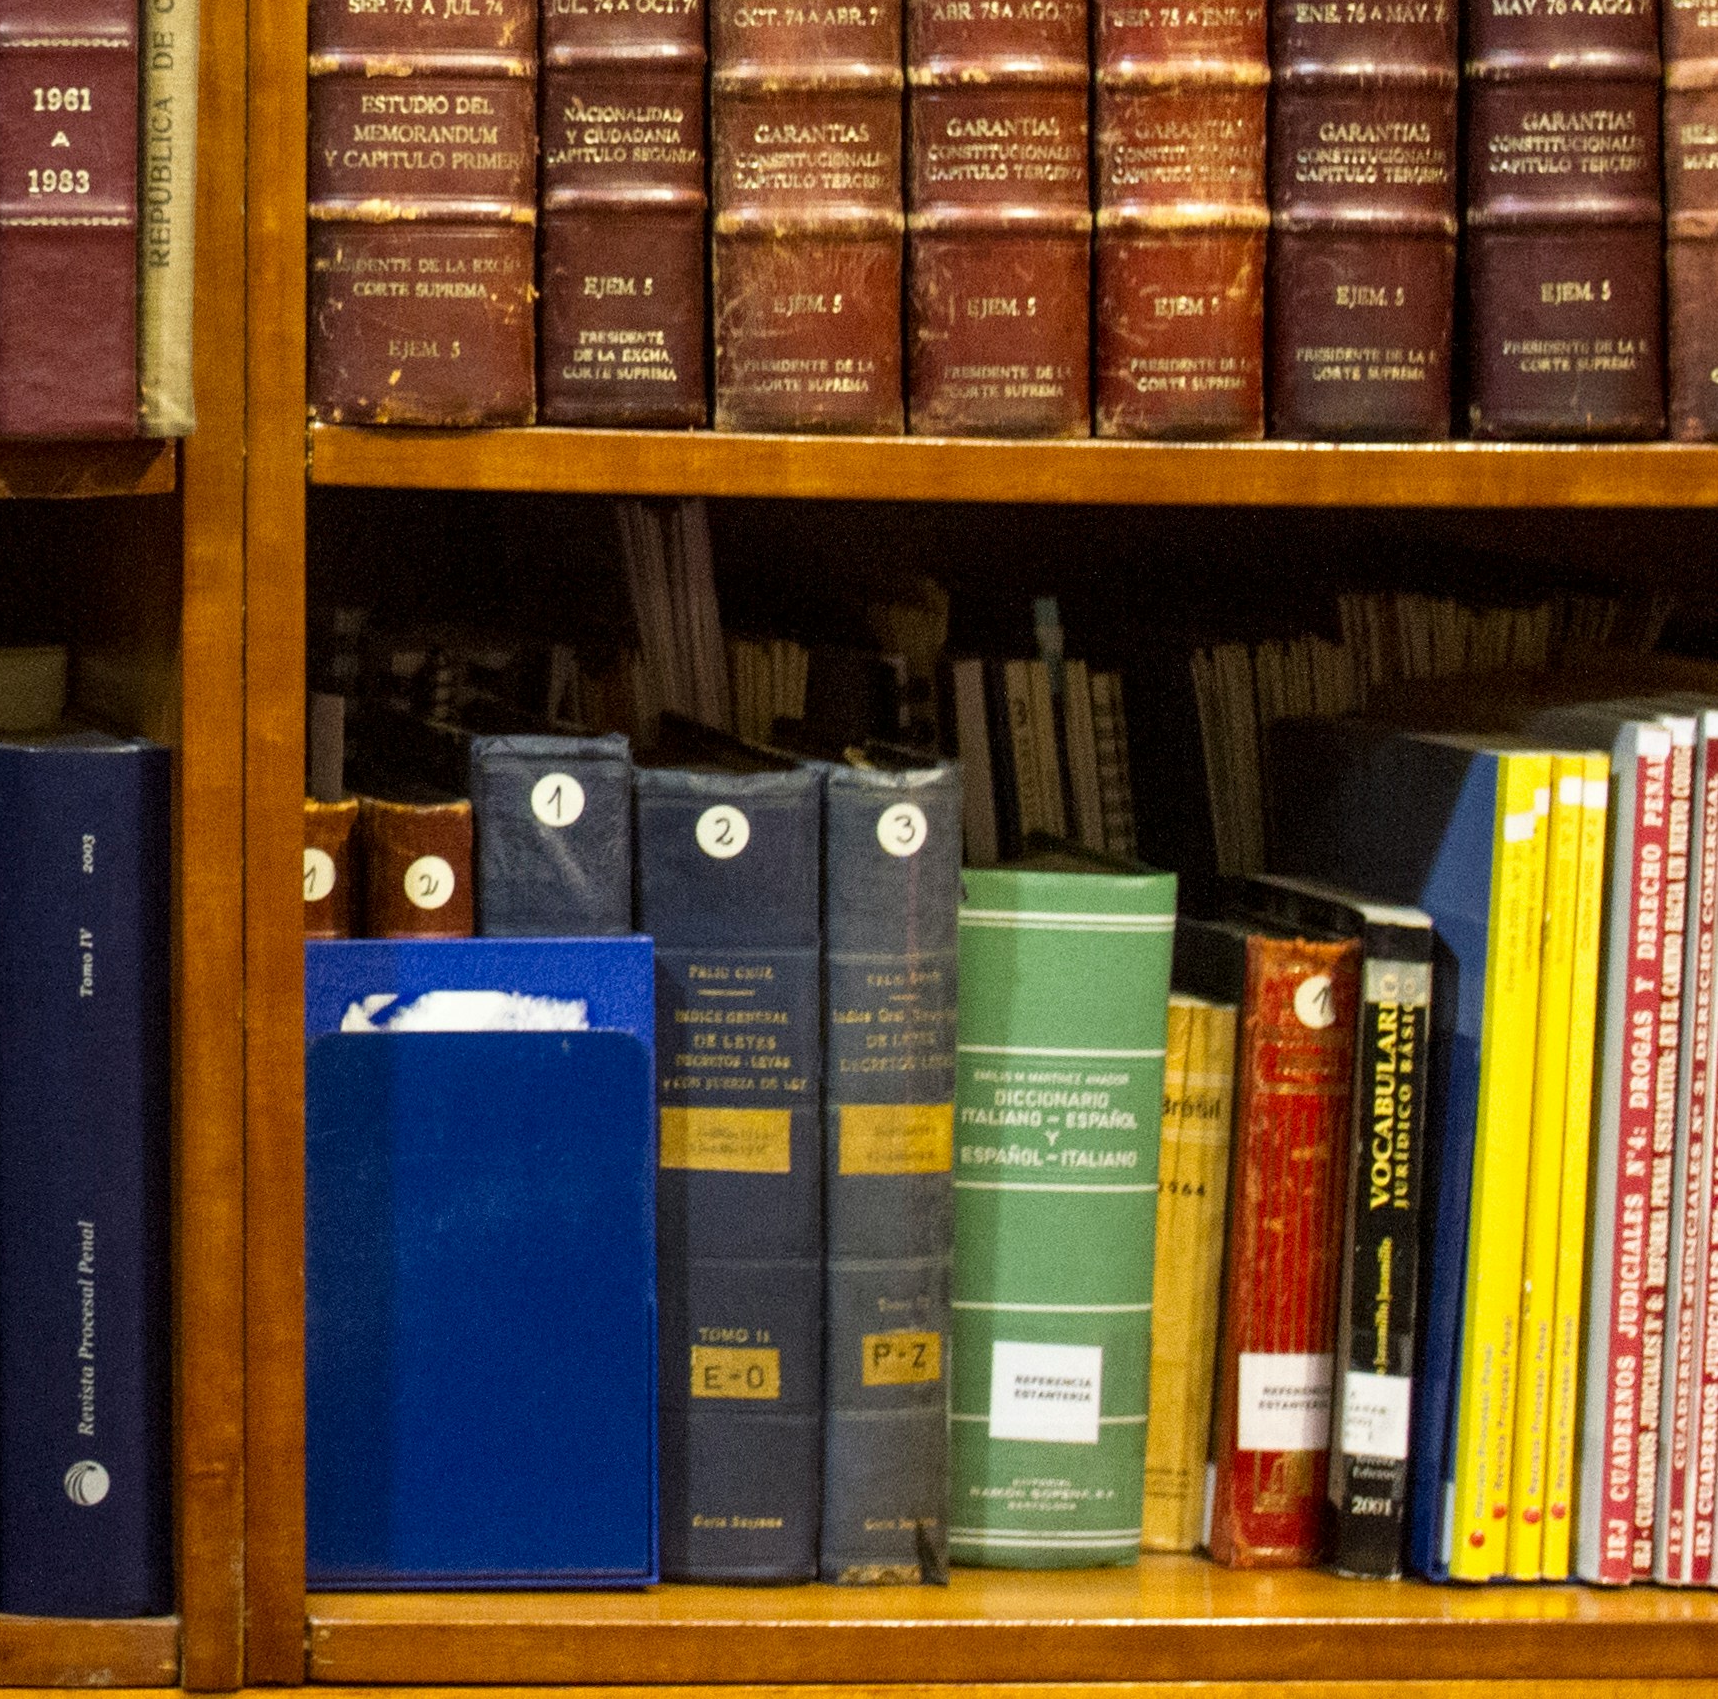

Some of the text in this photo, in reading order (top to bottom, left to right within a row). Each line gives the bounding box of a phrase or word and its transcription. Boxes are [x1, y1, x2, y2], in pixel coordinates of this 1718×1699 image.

[151, 30, 175, 71] DE
[33, 88, 92, 112] 1961
[362, 96, 494, 116] ESTUDIO DEL
[51, 131, 70, 148] A
[353, 124, 498, 145] MEMORANDUM
[28, 170, 90, 194] 1983
[148, 95, 175, 269] REPUBLICA
[714, 818, 734, 846] 2
[894, 814, 916, 845] 3
[81, 834, 96, 874] 2003
[1637, 843, 1662, 961] DERECHO
[80, 928, 94, 997] Tomo IV
[1633, 975, 1655, 993] Y
[1629, 1009, 1653, 1109] DROGAS
[994, 1088, 1109, 1108] DICCIONARIO
[962, 1108, 1042, 1127] ITALIANO
[1066, 1108, 1138, 1129] ESPAÑOL
[1044, 1130, 1059, 1146] Y
[961, 1144, 1043, 1166] ESPAÑOL
[1061, 1151, 1137, 1168] ITALIANO
[1617, 1193, 1644, 1338] JUDICIALES
[78, 1220, 95, 1437] Revista Procesal Penal
[1609, 1355, 1637, 1502] CUADERNOS
[1351, 1496, 1391, 1516] 2001
[1606, 1520, 1627, 1560] IEJ
